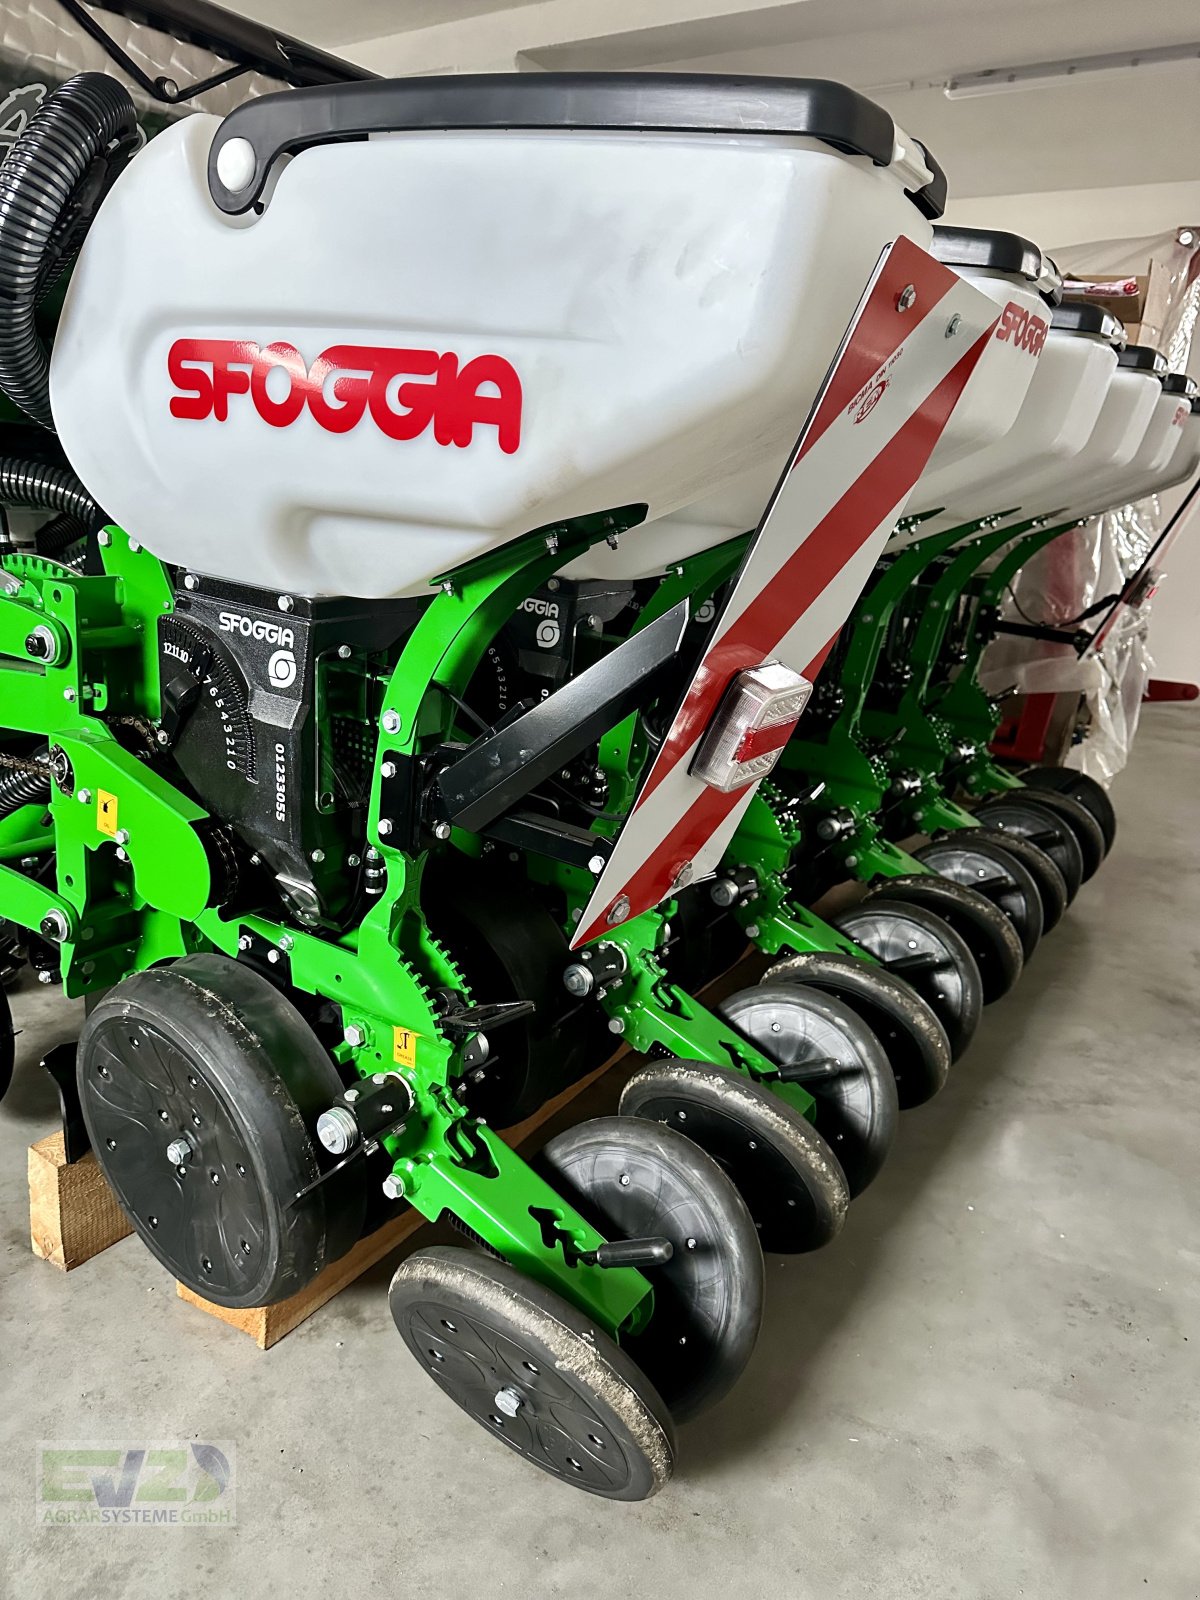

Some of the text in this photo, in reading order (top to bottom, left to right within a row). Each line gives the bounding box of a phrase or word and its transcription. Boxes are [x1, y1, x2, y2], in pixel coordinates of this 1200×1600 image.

[168, 338, 523, 454] SFOGGIA
[218, 611, 295, 649] SFOGGIA
[275, 743, 286, 823] 01233055
